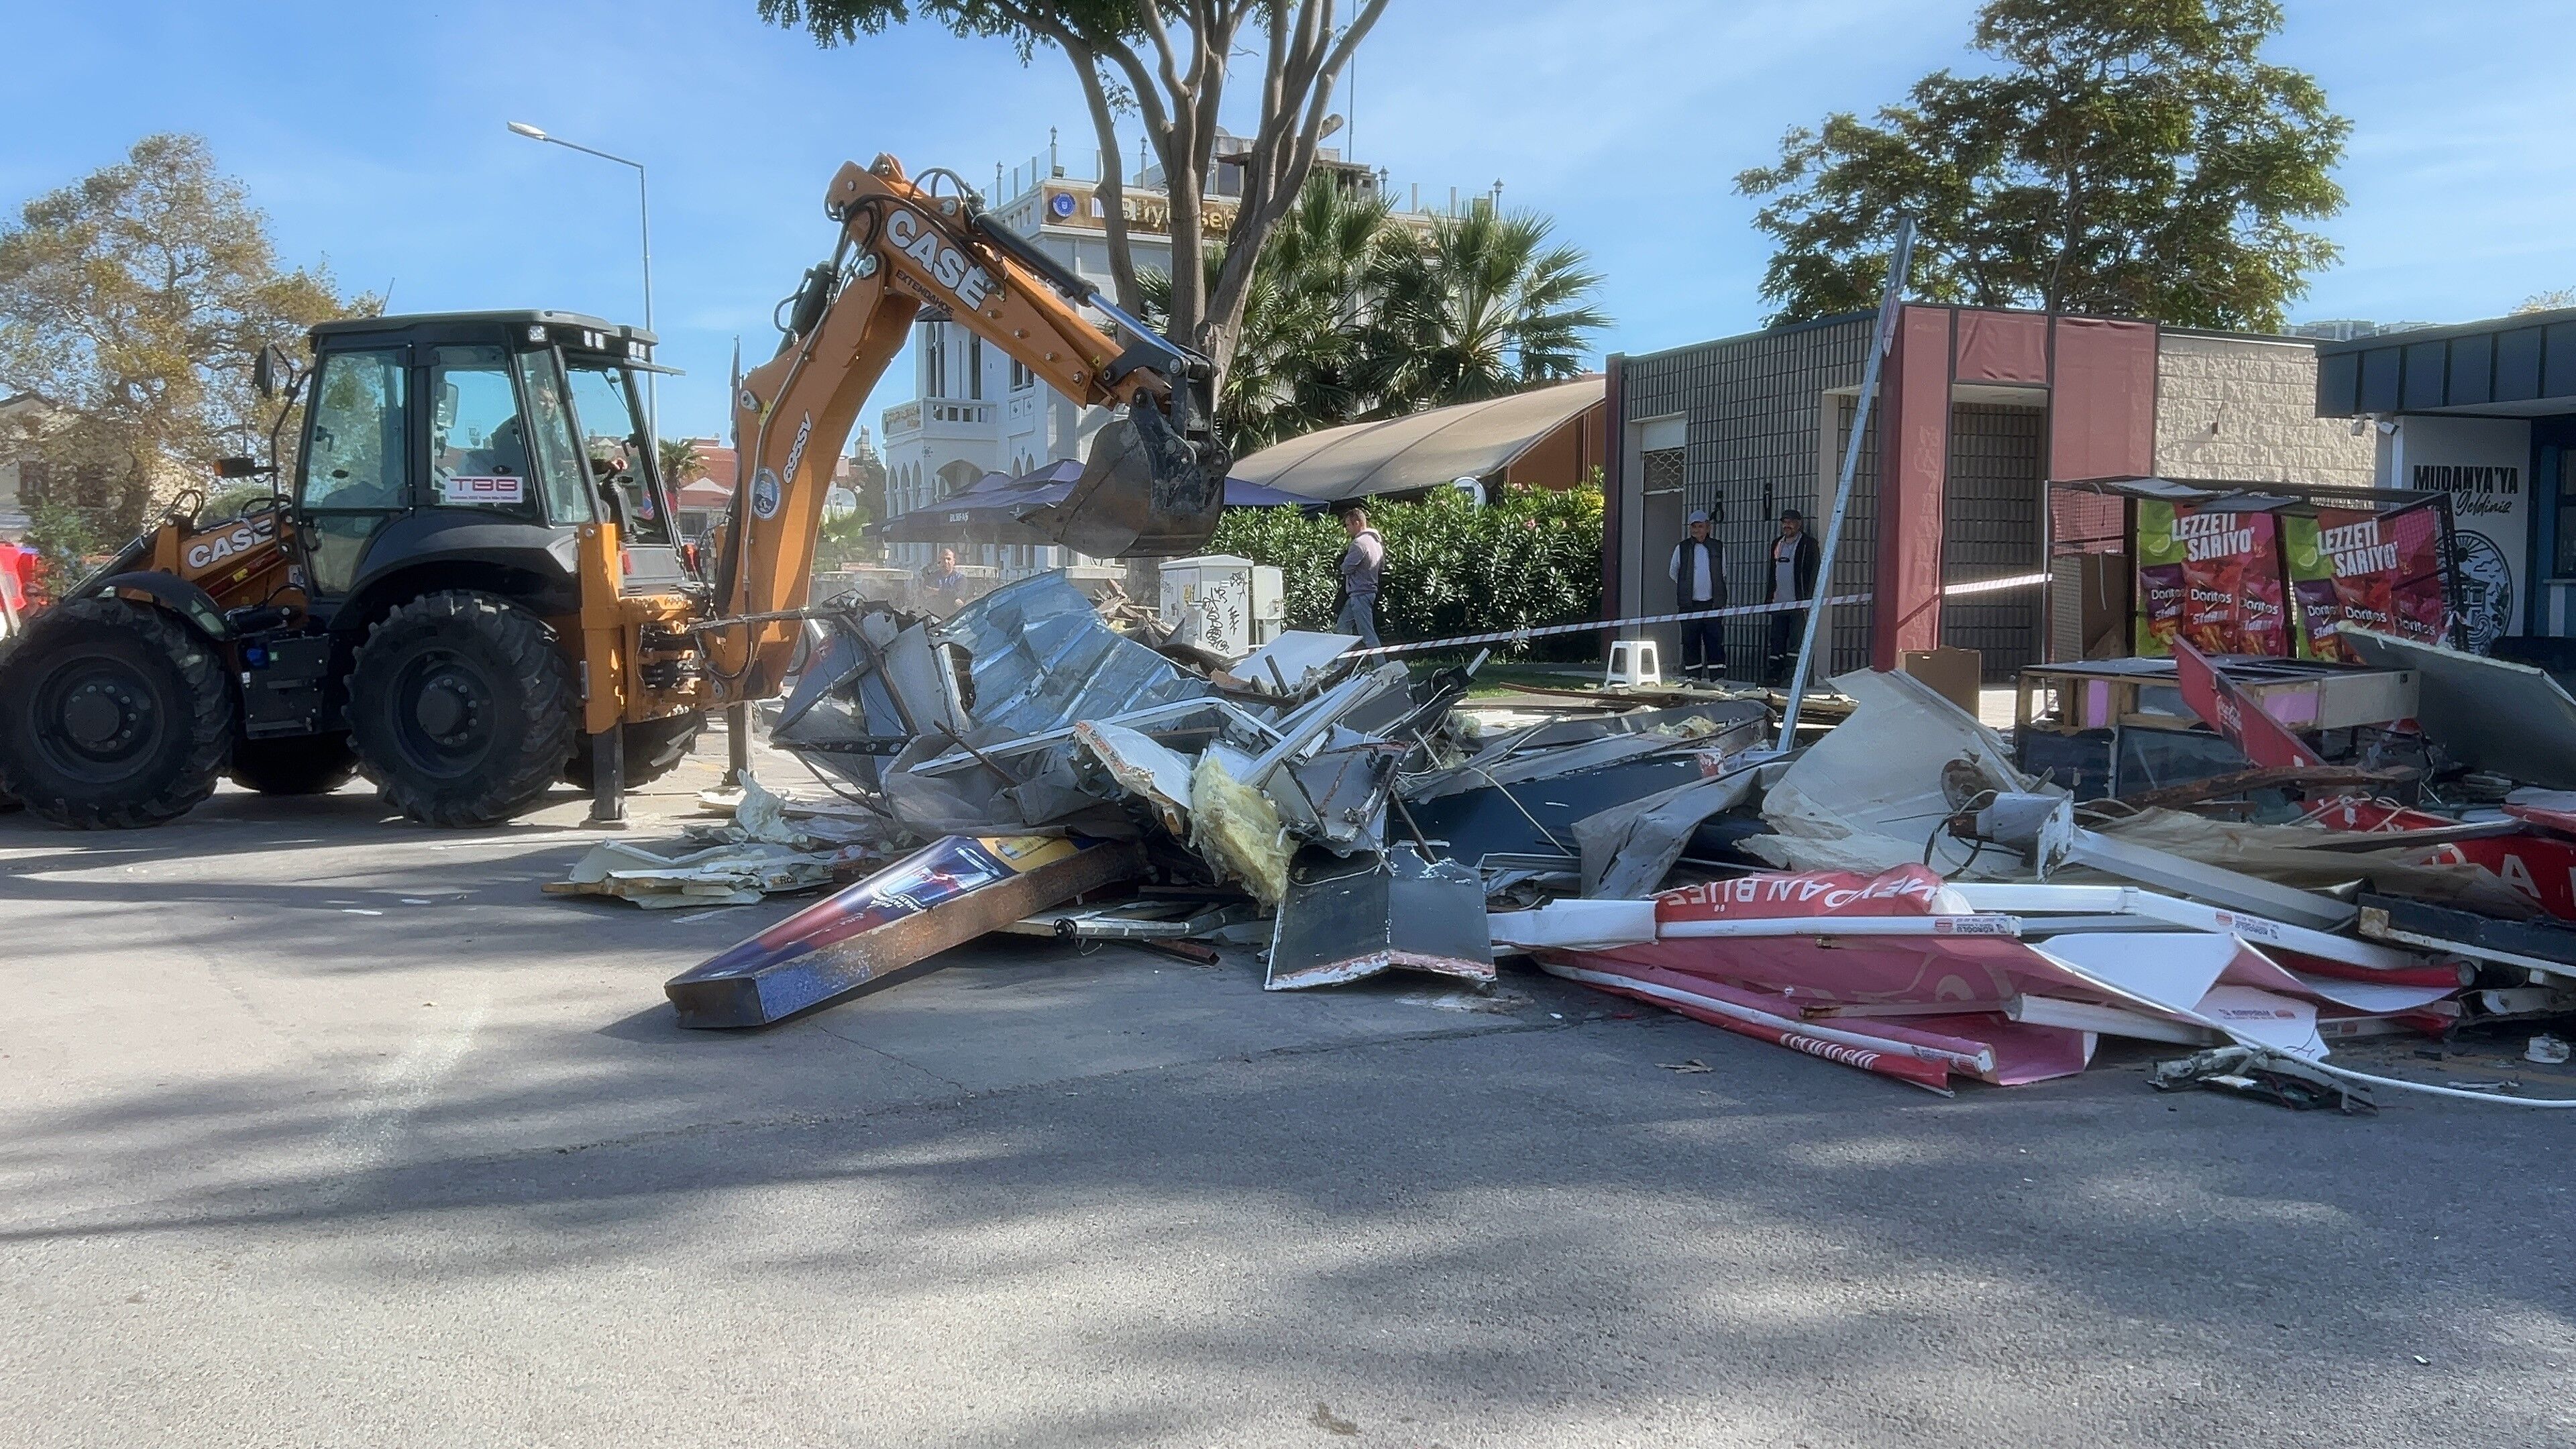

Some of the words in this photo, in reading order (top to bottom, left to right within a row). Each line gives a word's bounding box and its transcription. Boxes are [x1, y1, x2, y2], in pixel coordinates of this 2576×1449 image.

[886, 209, 988, 311] CASE
[450, 478, 518, 491] TBB
[2414, 465, 2518, 494] MUDANYA'YA
[189, 519, 273, 568] CASE
[2191, 588, 2233, 604] Doritos
[2345, 606, 2387, 623] Doritos
